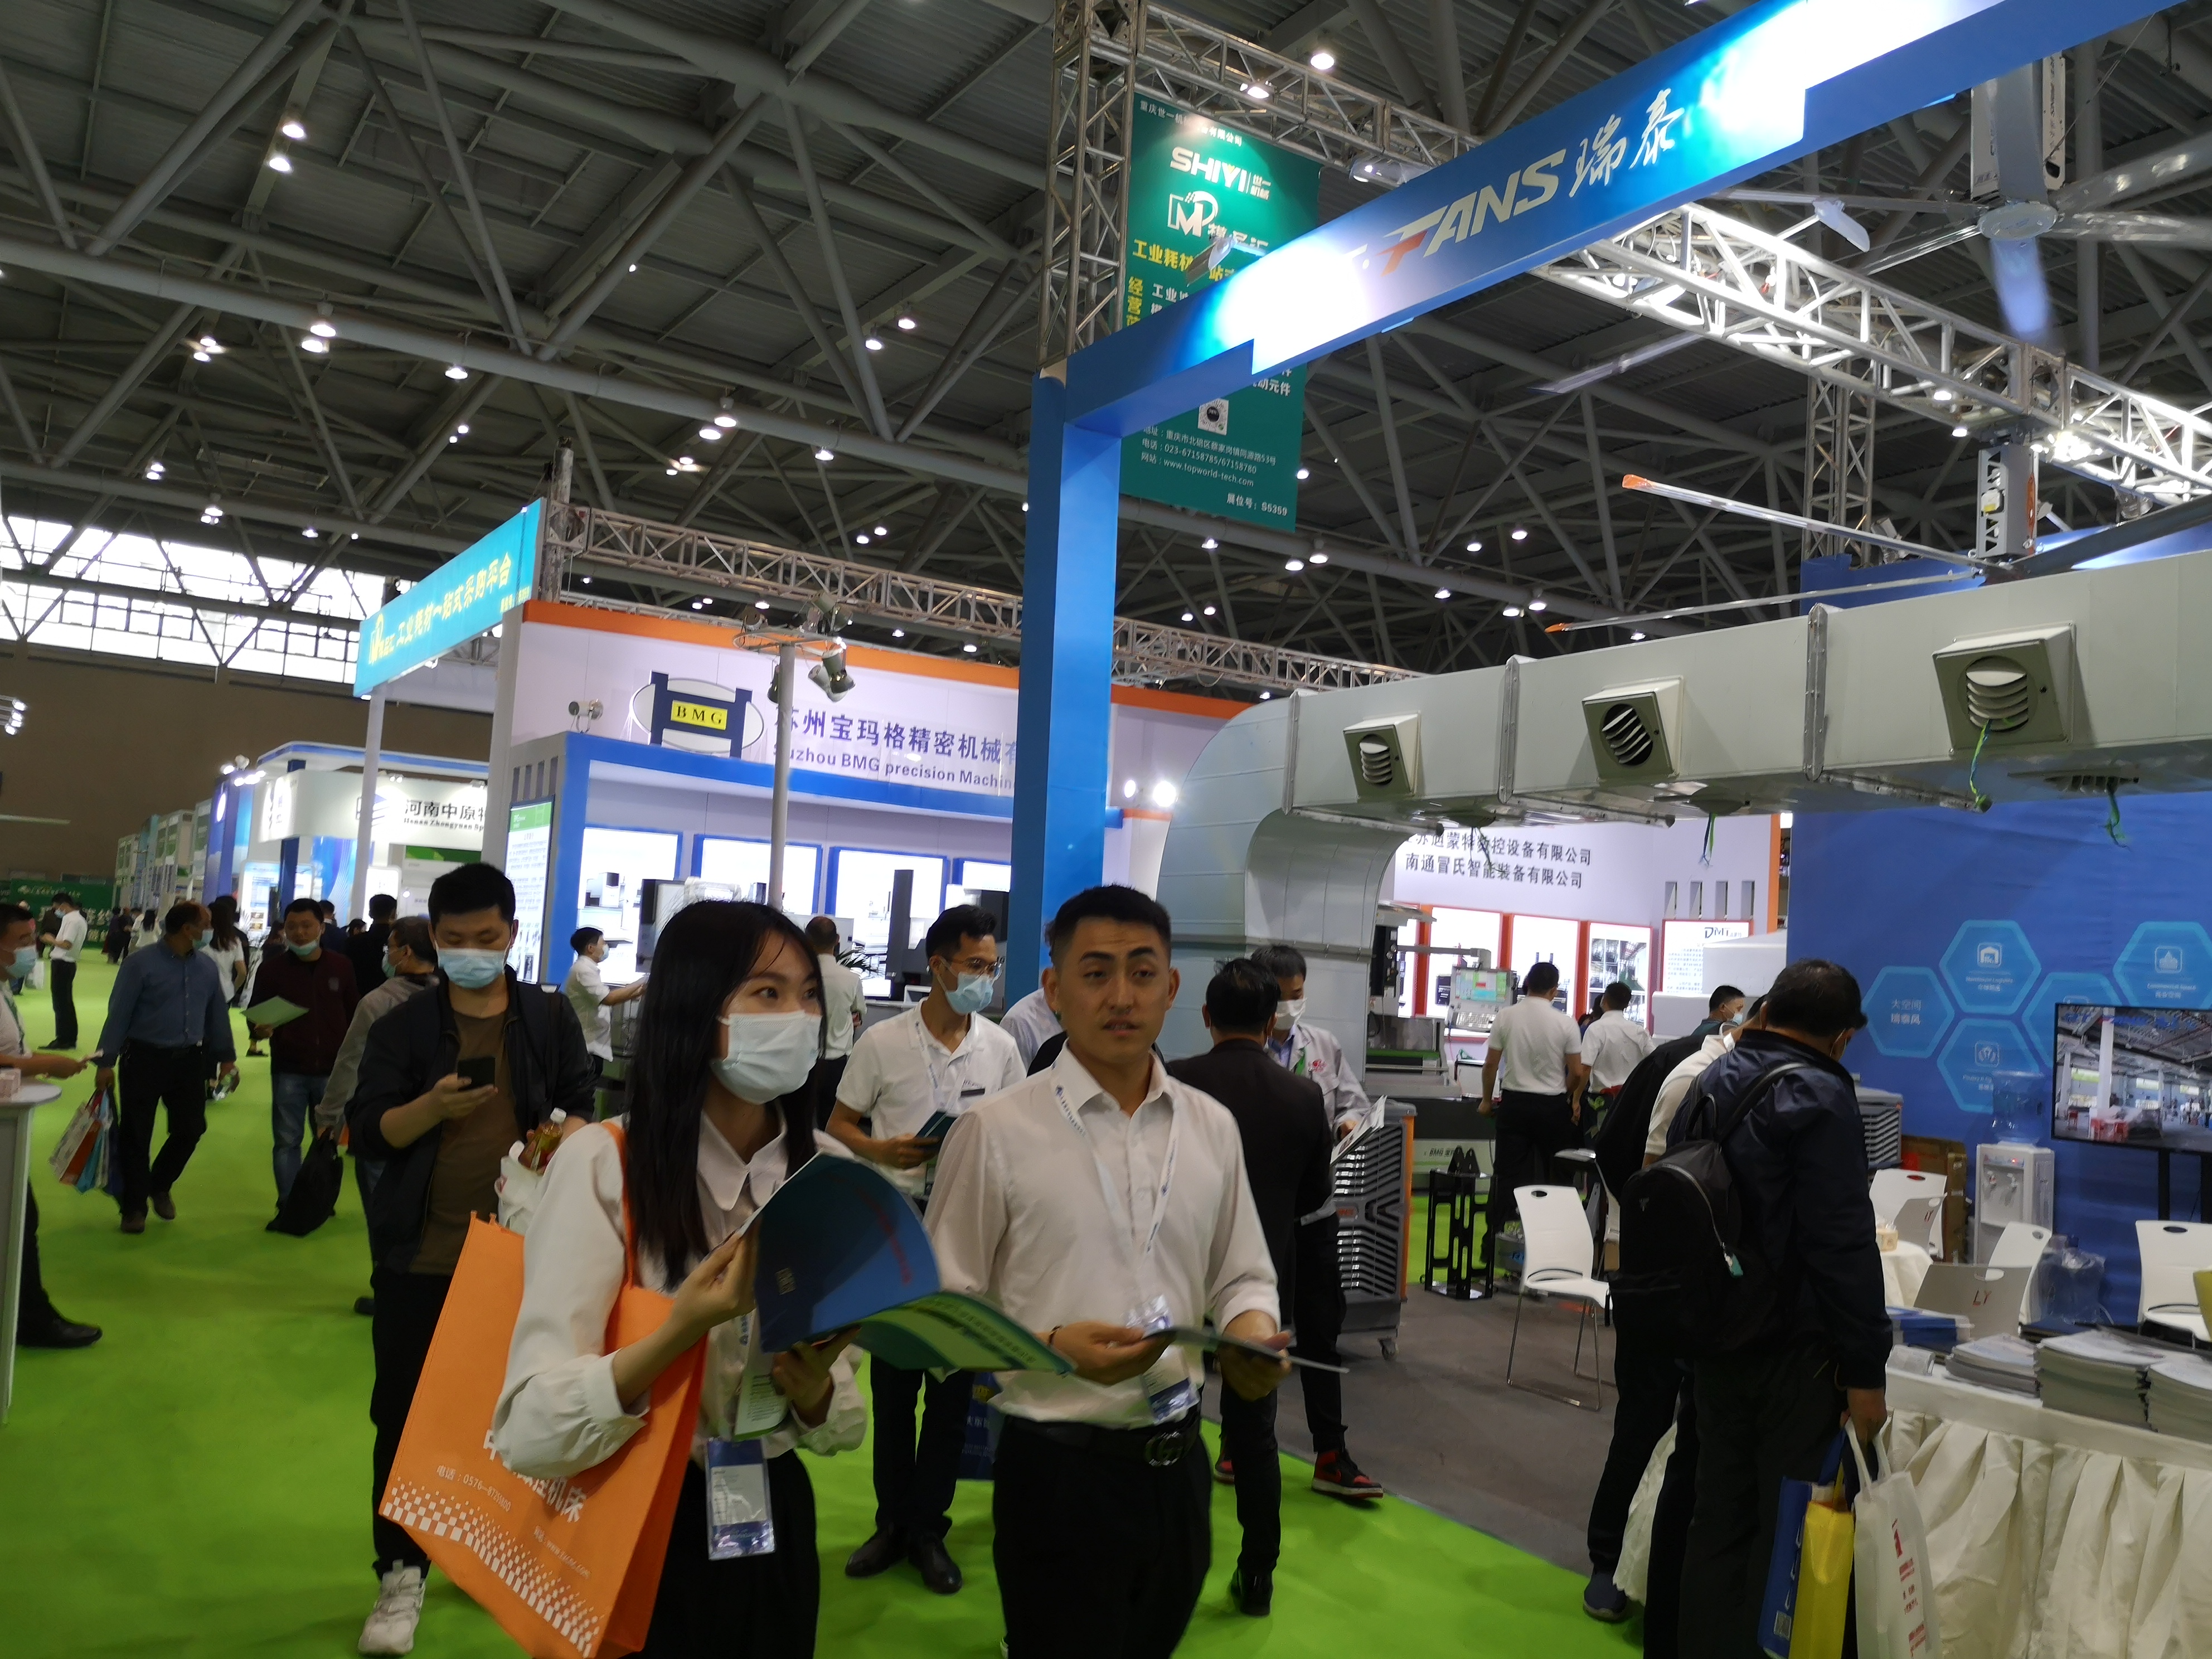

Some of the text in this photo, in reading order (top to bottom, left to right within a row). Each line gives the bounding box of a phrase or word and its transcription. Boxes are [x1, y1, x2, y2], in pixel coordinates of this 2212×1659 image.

[1569, 88, 1685, 198] 瑞泰
[1170, 146, 1248, 193] SHIYI
[1252, 378, 1291, 396] 动元件
[676, 705, 723, 724] BMG
[773, 745, 836, 766] zhou
[841, 754, 880, 772] BMG
[885, 763, 955, 782] precision
[1406, 831, 1591, 866] 苏迪蒙特数控设备有限公司
